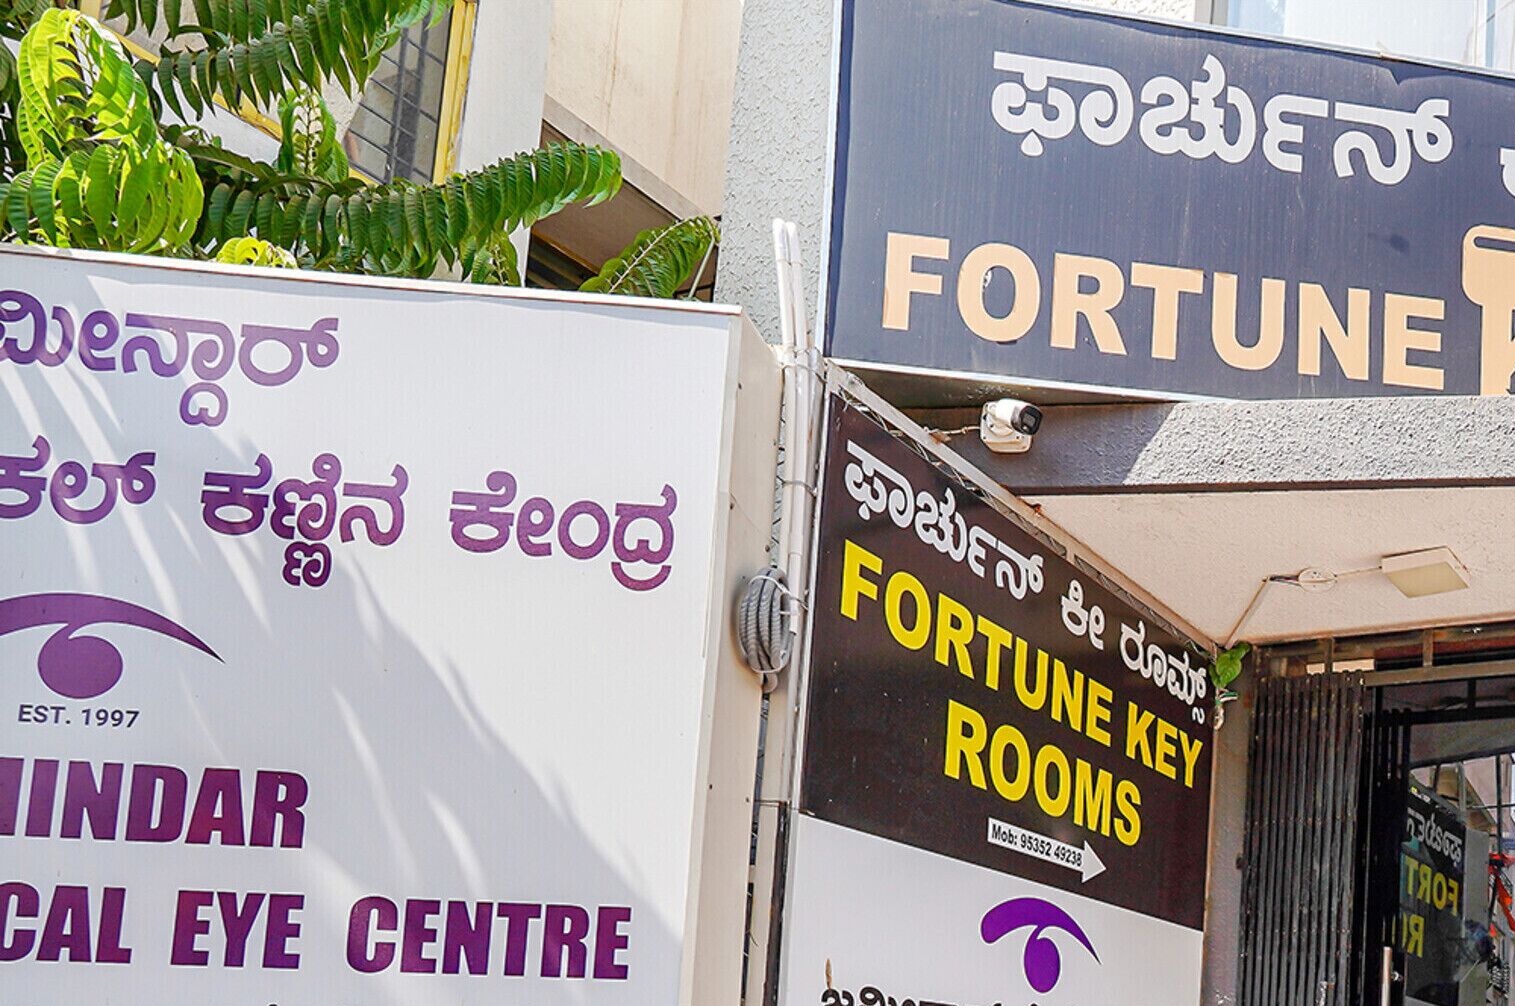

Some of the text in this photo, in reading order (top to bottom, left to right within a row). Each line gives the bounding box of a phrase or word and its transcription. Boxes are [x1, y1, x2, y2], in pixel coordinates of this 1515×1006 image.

[881, 231, 1447, 391] FORTUNE
[448, 469, 679, 592] ಕೇಂದ್ರ
[838, 538, 1205, 789] FORTUNE KEY
[1060, 579, 1106, 651] ಕೀ
[17, 702, 141, 730] EST. 1997
[943, 698, 1143, 848] ROOMS
[991, 823, 1018, 846] Mob:
[1020, 833, 1053, 857] 95352
[0, 881, 633, 982] CAL EYE CENTRE
